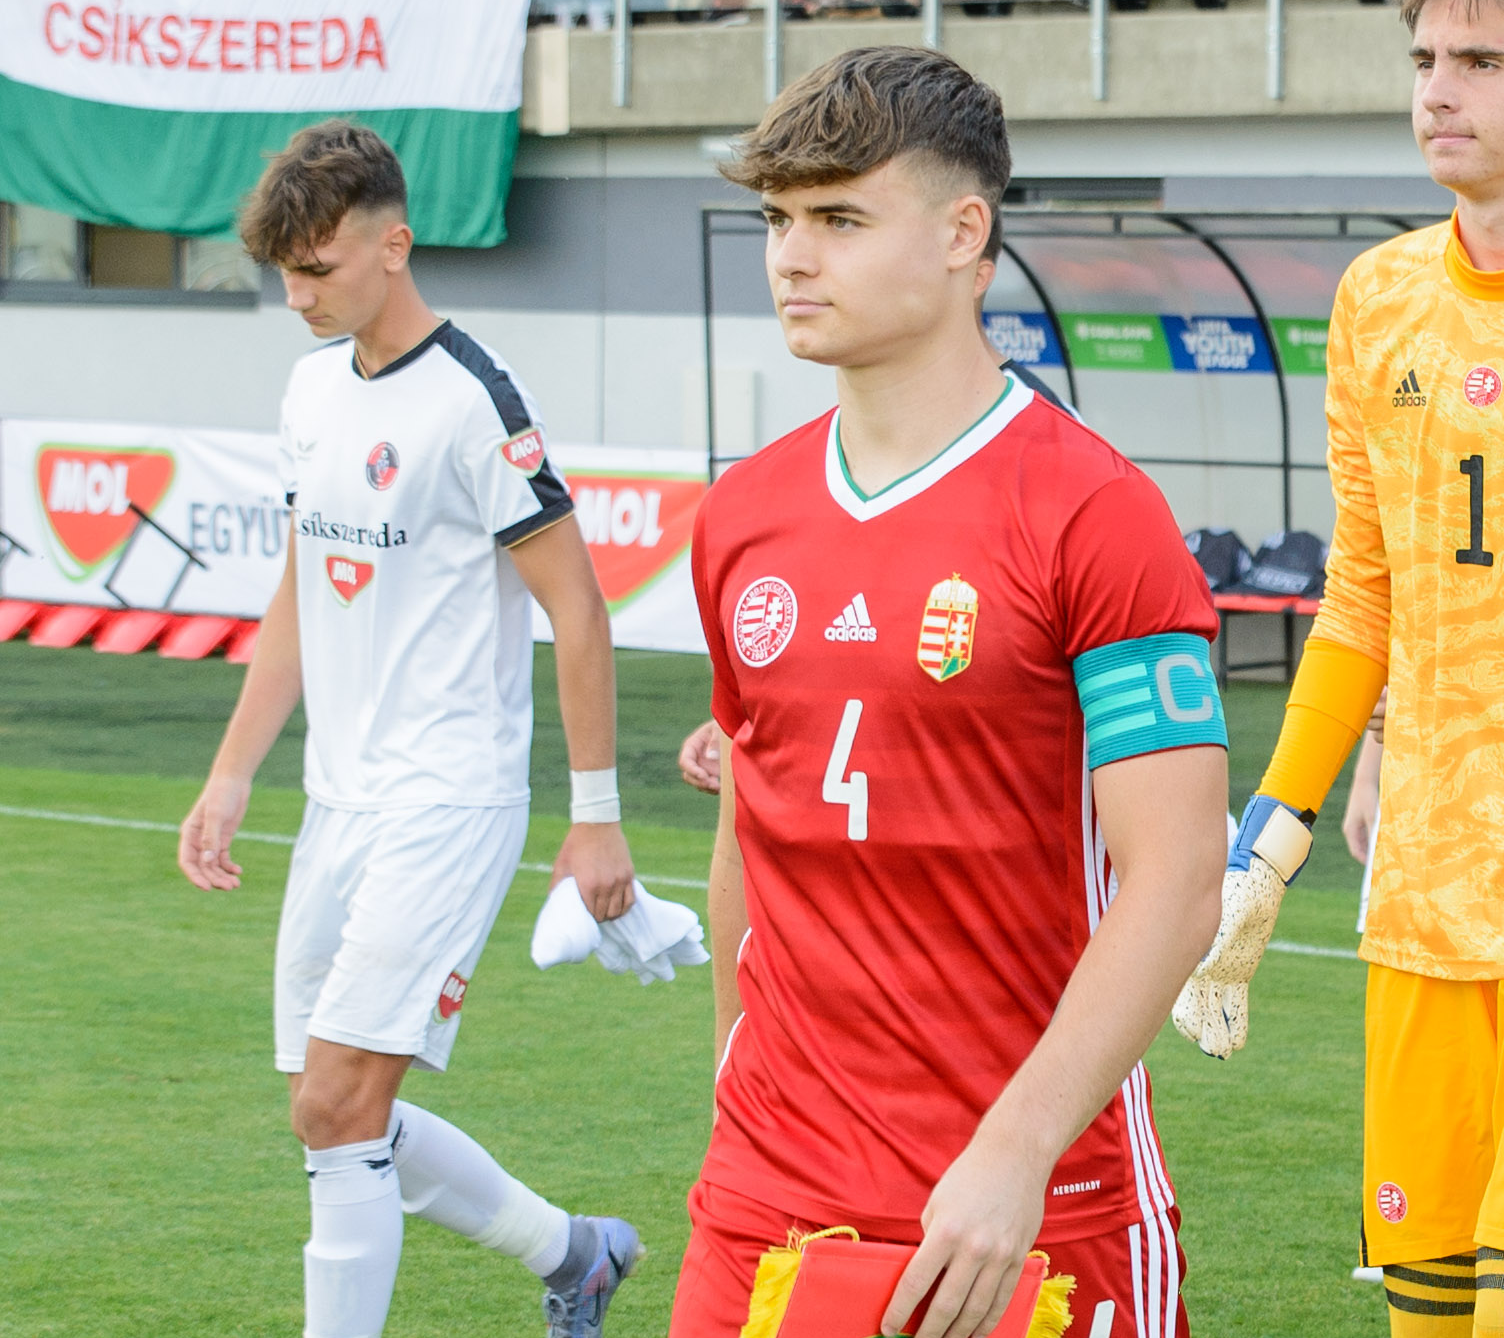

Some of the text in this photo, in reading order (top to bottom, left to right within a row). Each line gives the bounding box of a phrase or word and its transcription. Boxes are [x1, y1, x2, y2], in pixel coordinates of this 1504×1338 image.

[1392, 394, 1426, 407] adidas
[511, 430, 542, 462] MOL
[48, 458, 131, 516] MOL
[1455, 455, 1494, 567] 1
[190, 495, 294, 557] EGYÜ
[574, 487, 664, 547] MOL
[333, 561, 358, 586] MOL
[824, 624, 877, 642] adidas
[1155, 653, 1214, 723] C
[822, 699, 870, 841] 4
[1052, 1179, 1102, 1197] AEROREADY
